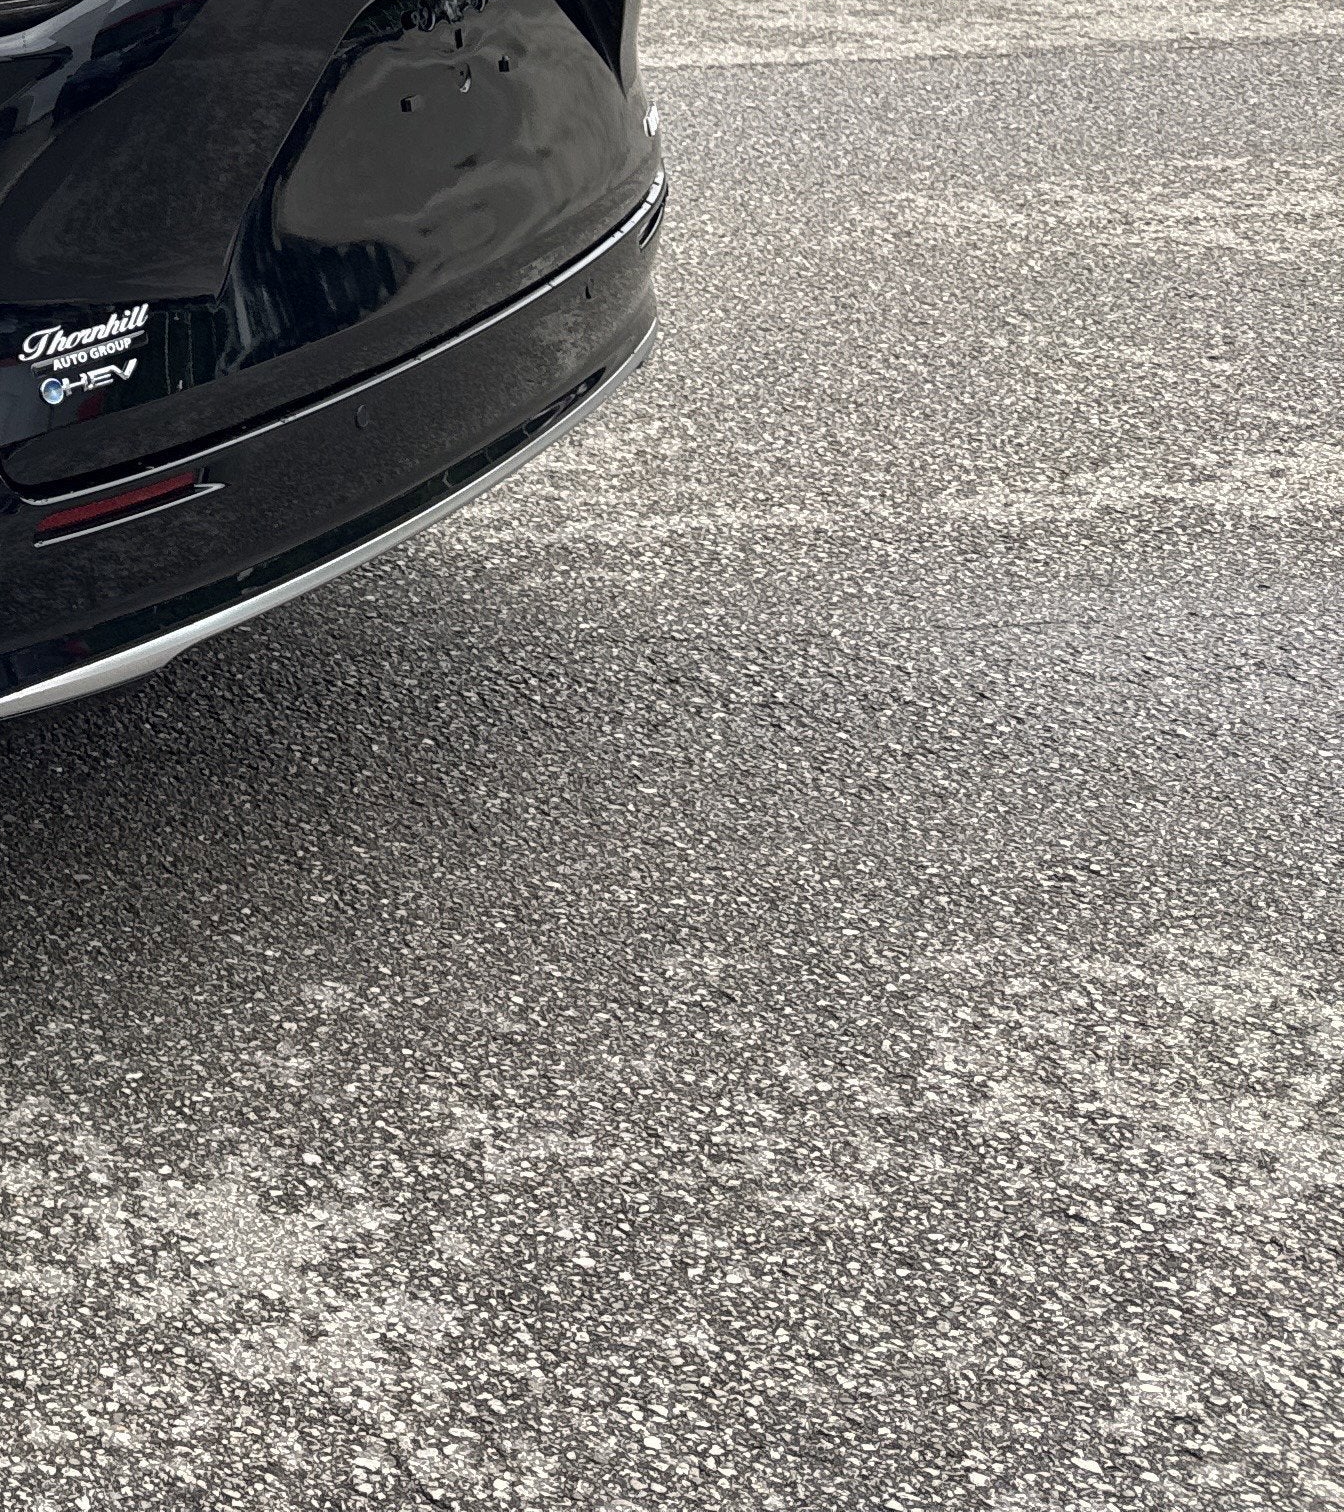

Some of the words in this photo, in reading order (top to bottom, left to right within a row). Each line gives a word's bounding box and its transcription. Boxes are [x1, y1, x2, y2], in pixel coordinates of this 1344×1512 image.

[18, 303, 149, 362] Thornhill
[53, 351, 88, 371] AUTO
[89, 337, 132, 360] GROUP
[61, 358, 138, 397] HEV
